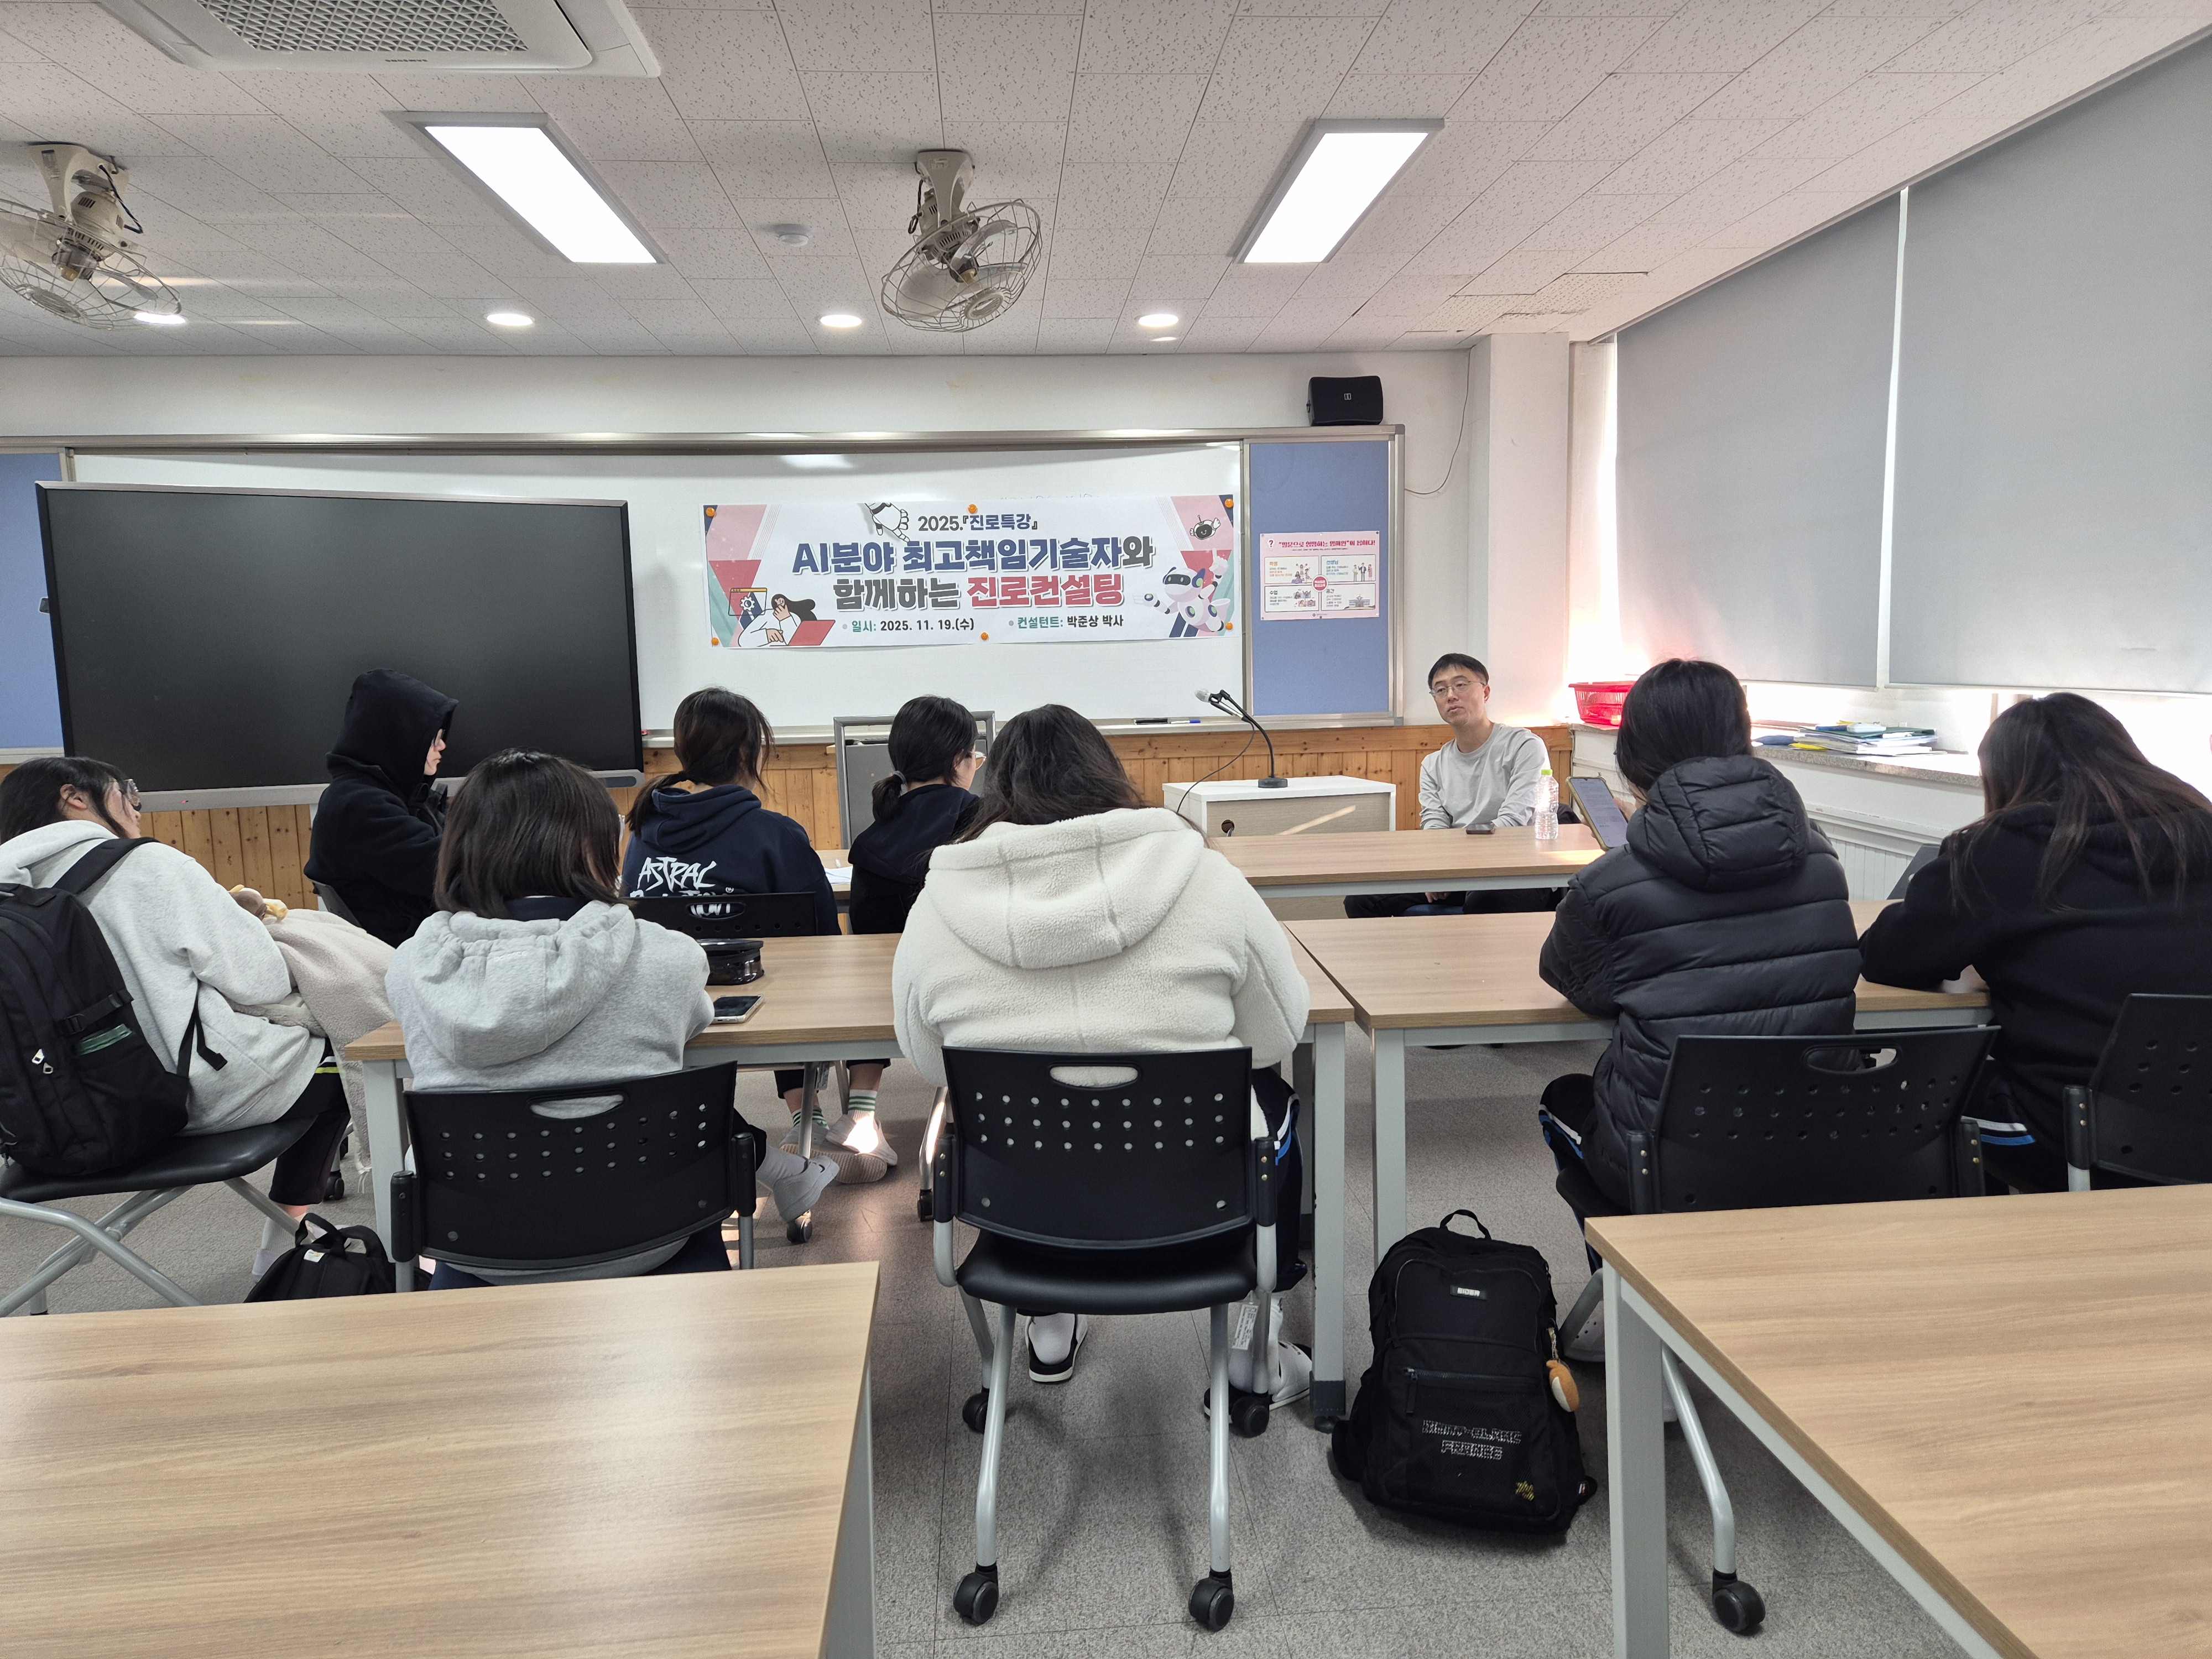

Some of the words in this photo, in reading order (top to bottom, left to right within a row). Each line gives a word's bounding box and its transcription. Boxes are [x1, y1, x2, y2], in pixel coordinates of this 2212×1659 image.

[917, 514, 1038, 531] 2025.『진로특강』
[792, 541, 895, 573] AI분야
[902, 536, 1154, 573] 최고책임기술자와
[833, 578, 959, 610] 함께하는
[967, 573, 1123, 607] 진로컨설팅
[852, 620, 877, 633] 일시:
[880, 620, 912, 631] 2025.
[916, 620, 934, 631] 11.
[937, 618, 974, 631] 19.(수)
[1017, 617, 1063, 629] 컨설턴트:
[1067, 615, 1098, 628] 박준상
[1102, 614, 1124, 627] 박사
[637, 857, 717, 893] ASTRAL
